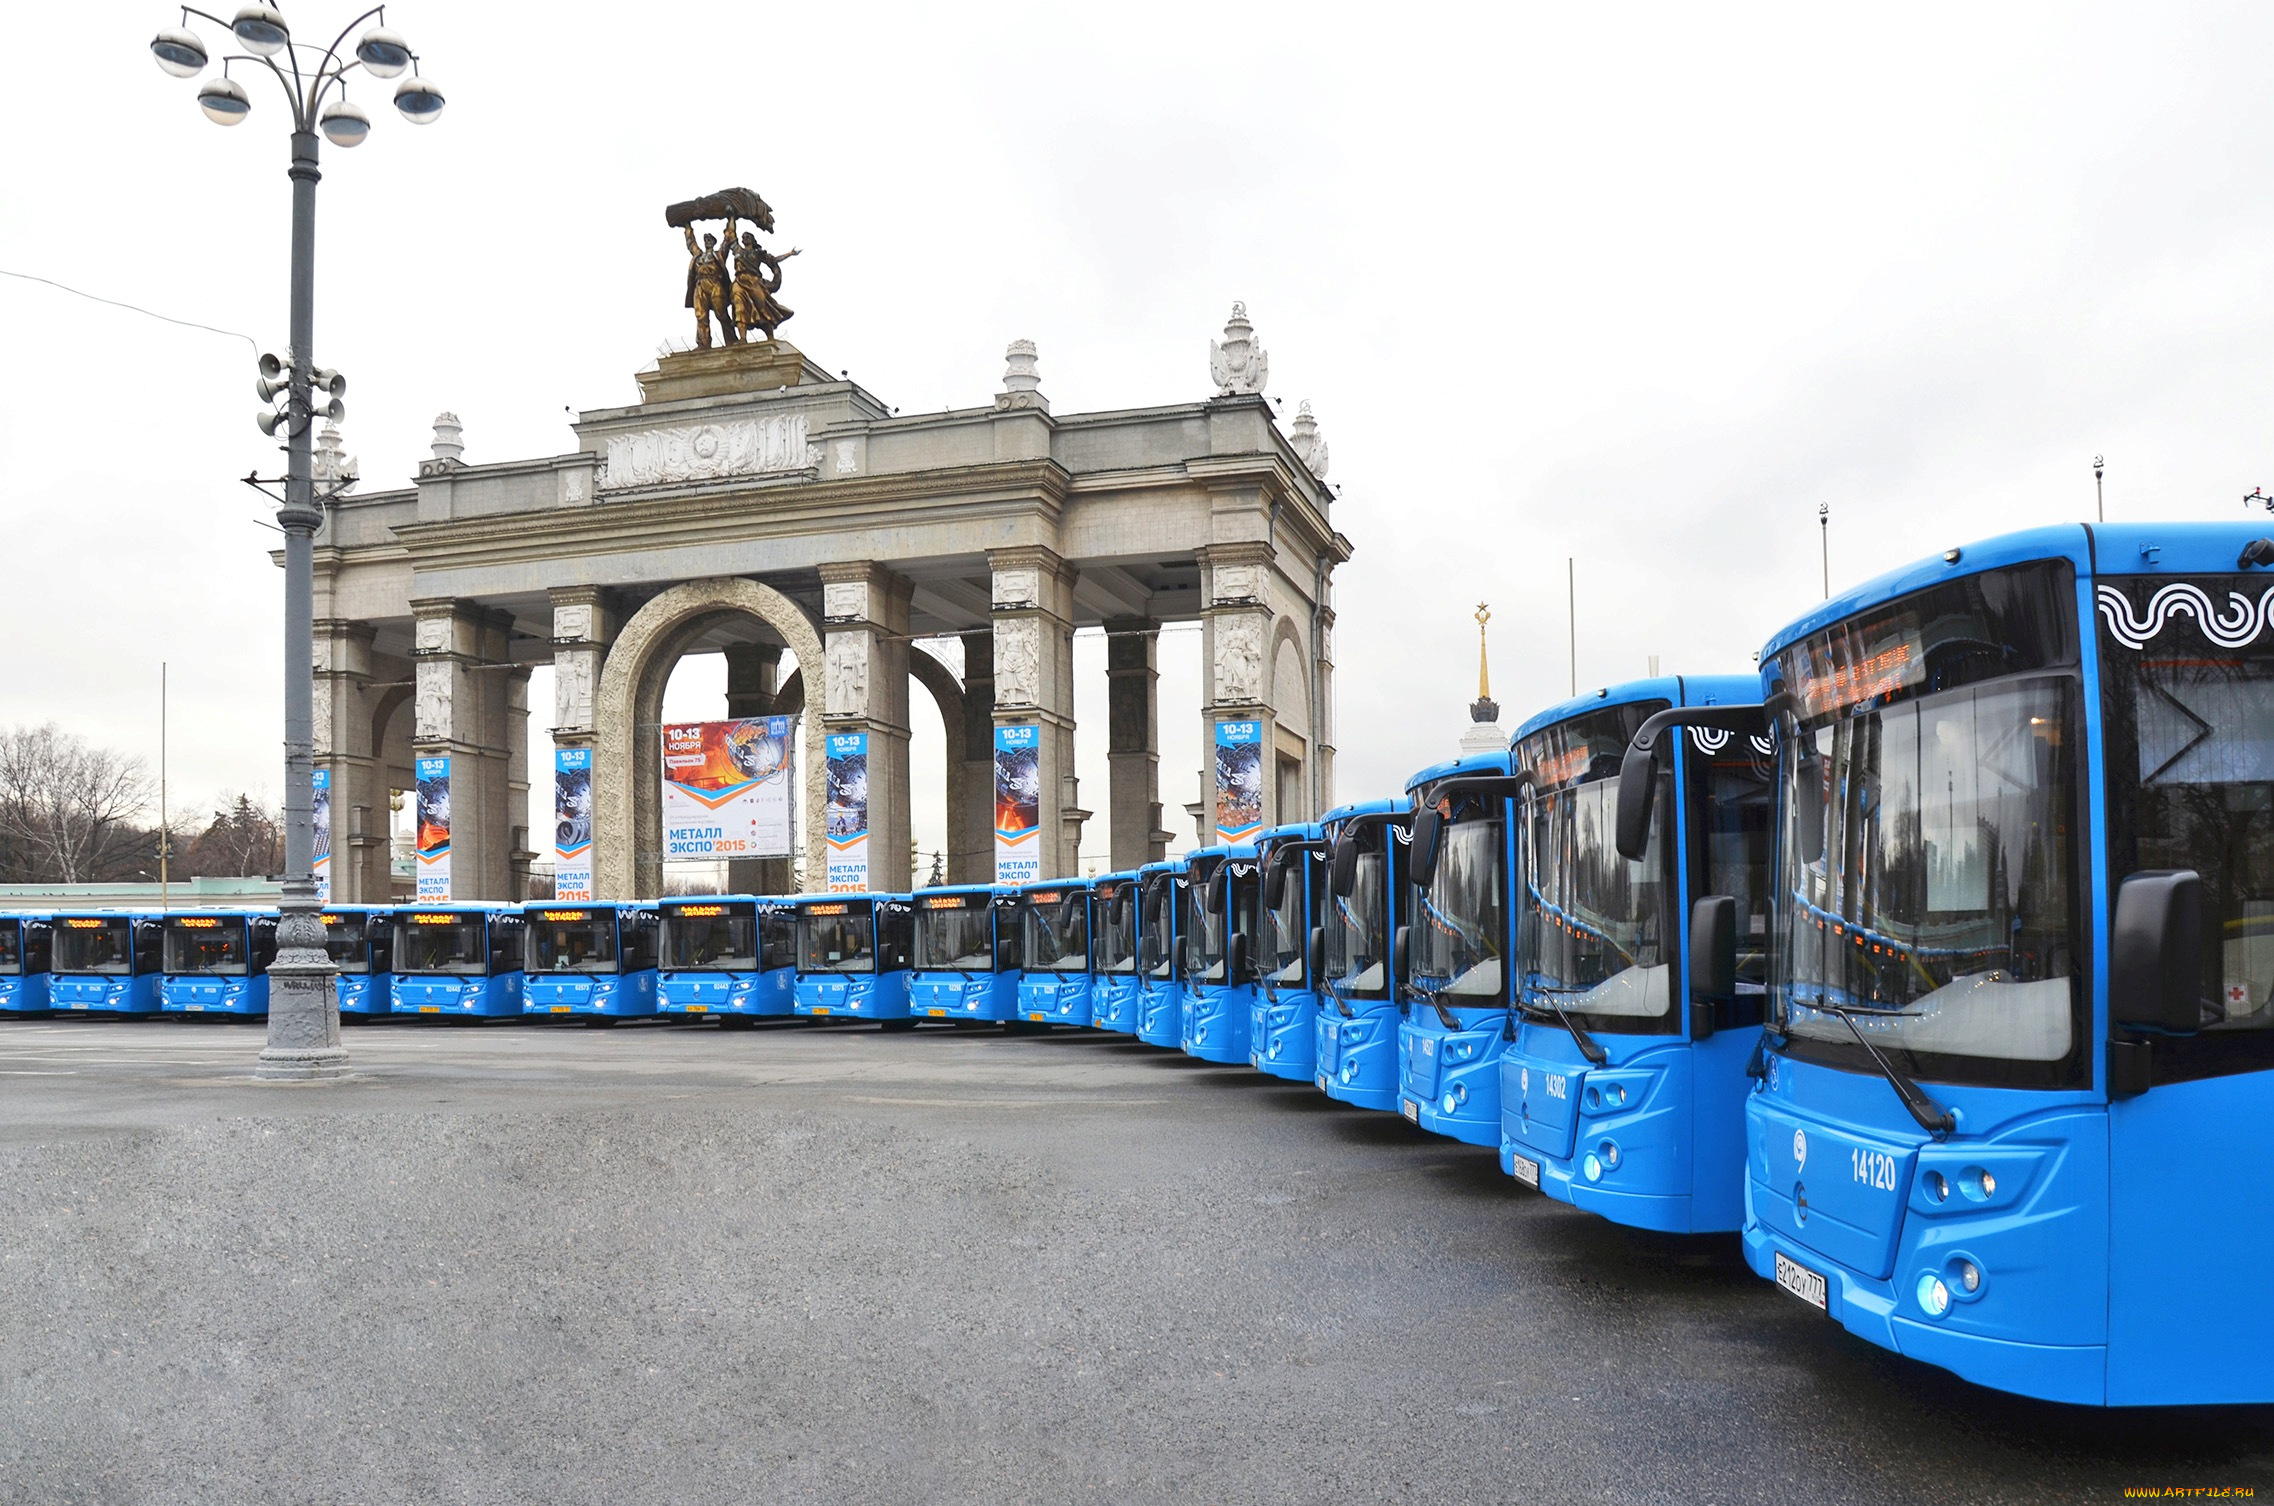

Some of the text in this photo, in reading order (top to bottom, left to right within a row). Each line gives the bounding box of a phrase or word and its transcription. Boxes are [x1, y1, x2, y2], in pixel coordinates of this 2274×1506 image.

[669, 727, 700, 740] 10-13
[1002, 728, 1031, 739] 10-13
[1223, 724, 1253, 734] 10-13
[669, 740, 701, 751] НОЯБРЯ
[833, 736, 860, 747] 10-13
[561, 751, 585, 761] 10-13
[421, 759, 444, 770] 10-13
[669, 827, 722, 840] МЕТАЛЛ
[829, 865, 866, 873] МЕТАЛЛ
[998, 861, 1038, 870] МЕТАЛЛ
[557, 872, 590, 880] МЕТАЛЛ
[829, 874, 859, 882] ЭКСПО
[998, 871, 1030, 879] ЭКСПО
[419, 878, 449, 886] МЕТАЛЛ
[557, 882, 584, 890] ЭКСПО
[419, 886, 444, 894] ЭКСПО
[557, 891, 590, 901] 2015
[1545, 1072, 1566, 1100] 14302
[1852, 1148, 1896, 1191] 14120
